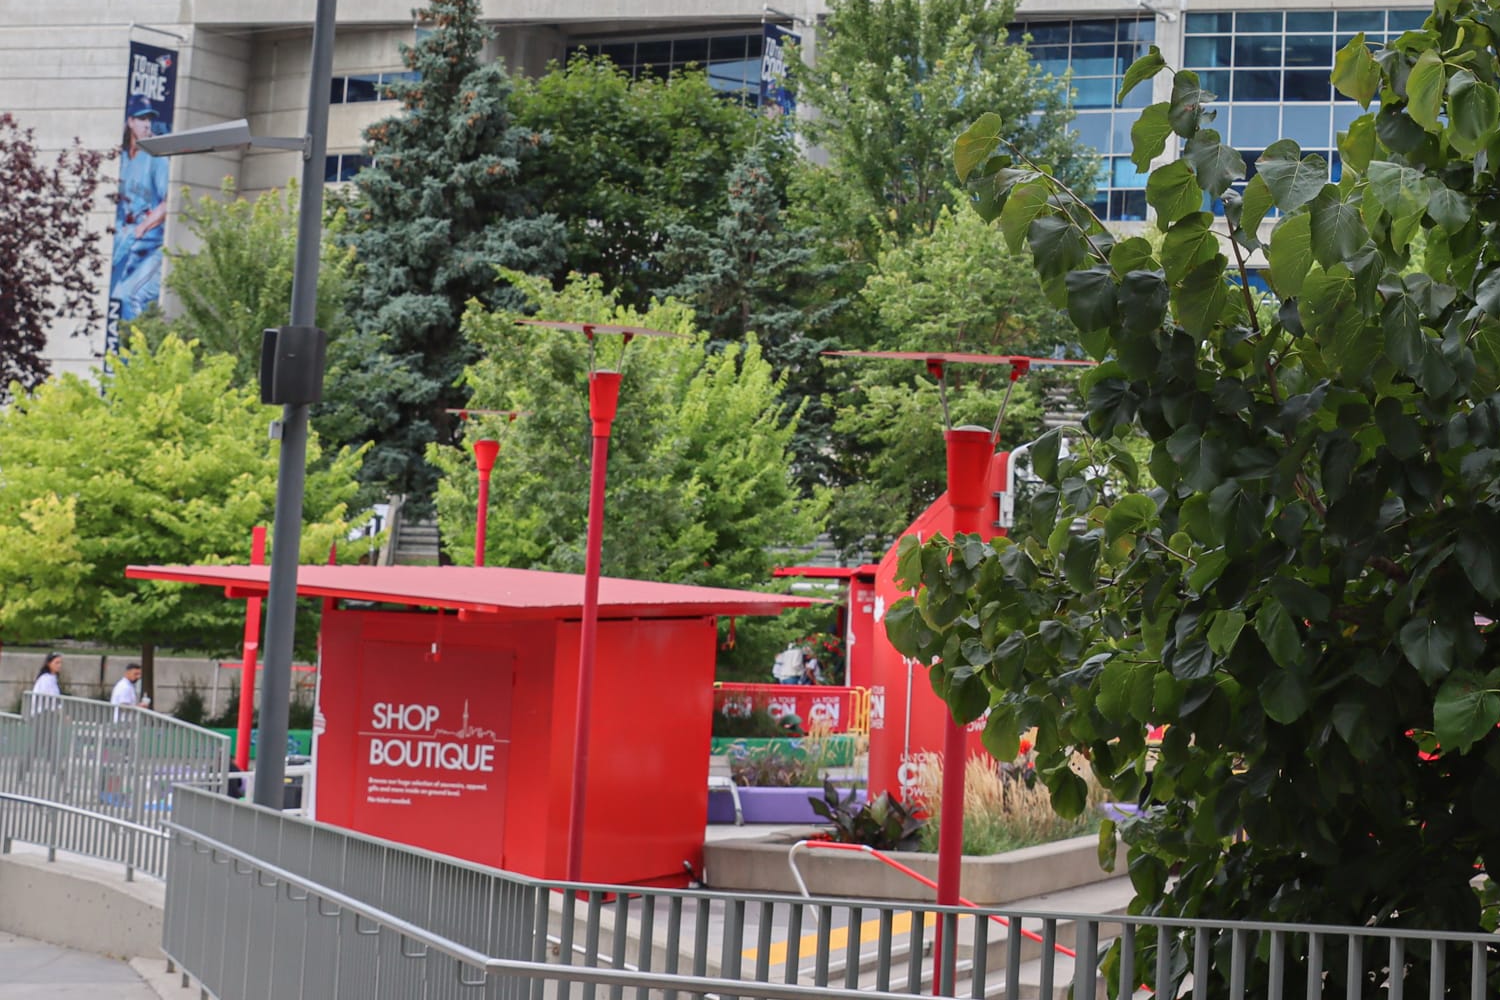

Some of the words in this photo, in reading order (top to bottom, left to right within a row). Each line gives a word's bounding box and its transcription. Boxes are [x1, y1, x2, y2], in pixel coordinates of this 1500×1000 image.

[133, 53, 148, 73] TO
[131, 71, 167, 102] CORE
[812, 696, 821, 704] LA
[821, 696, 840, 704] TOUR
[371, 702, 440, 731] SHOP
[767, 702, 796, 719] CN
[811, 703, 840, 720] CN
[369, 738, 495, 771] BOUTIQUE
